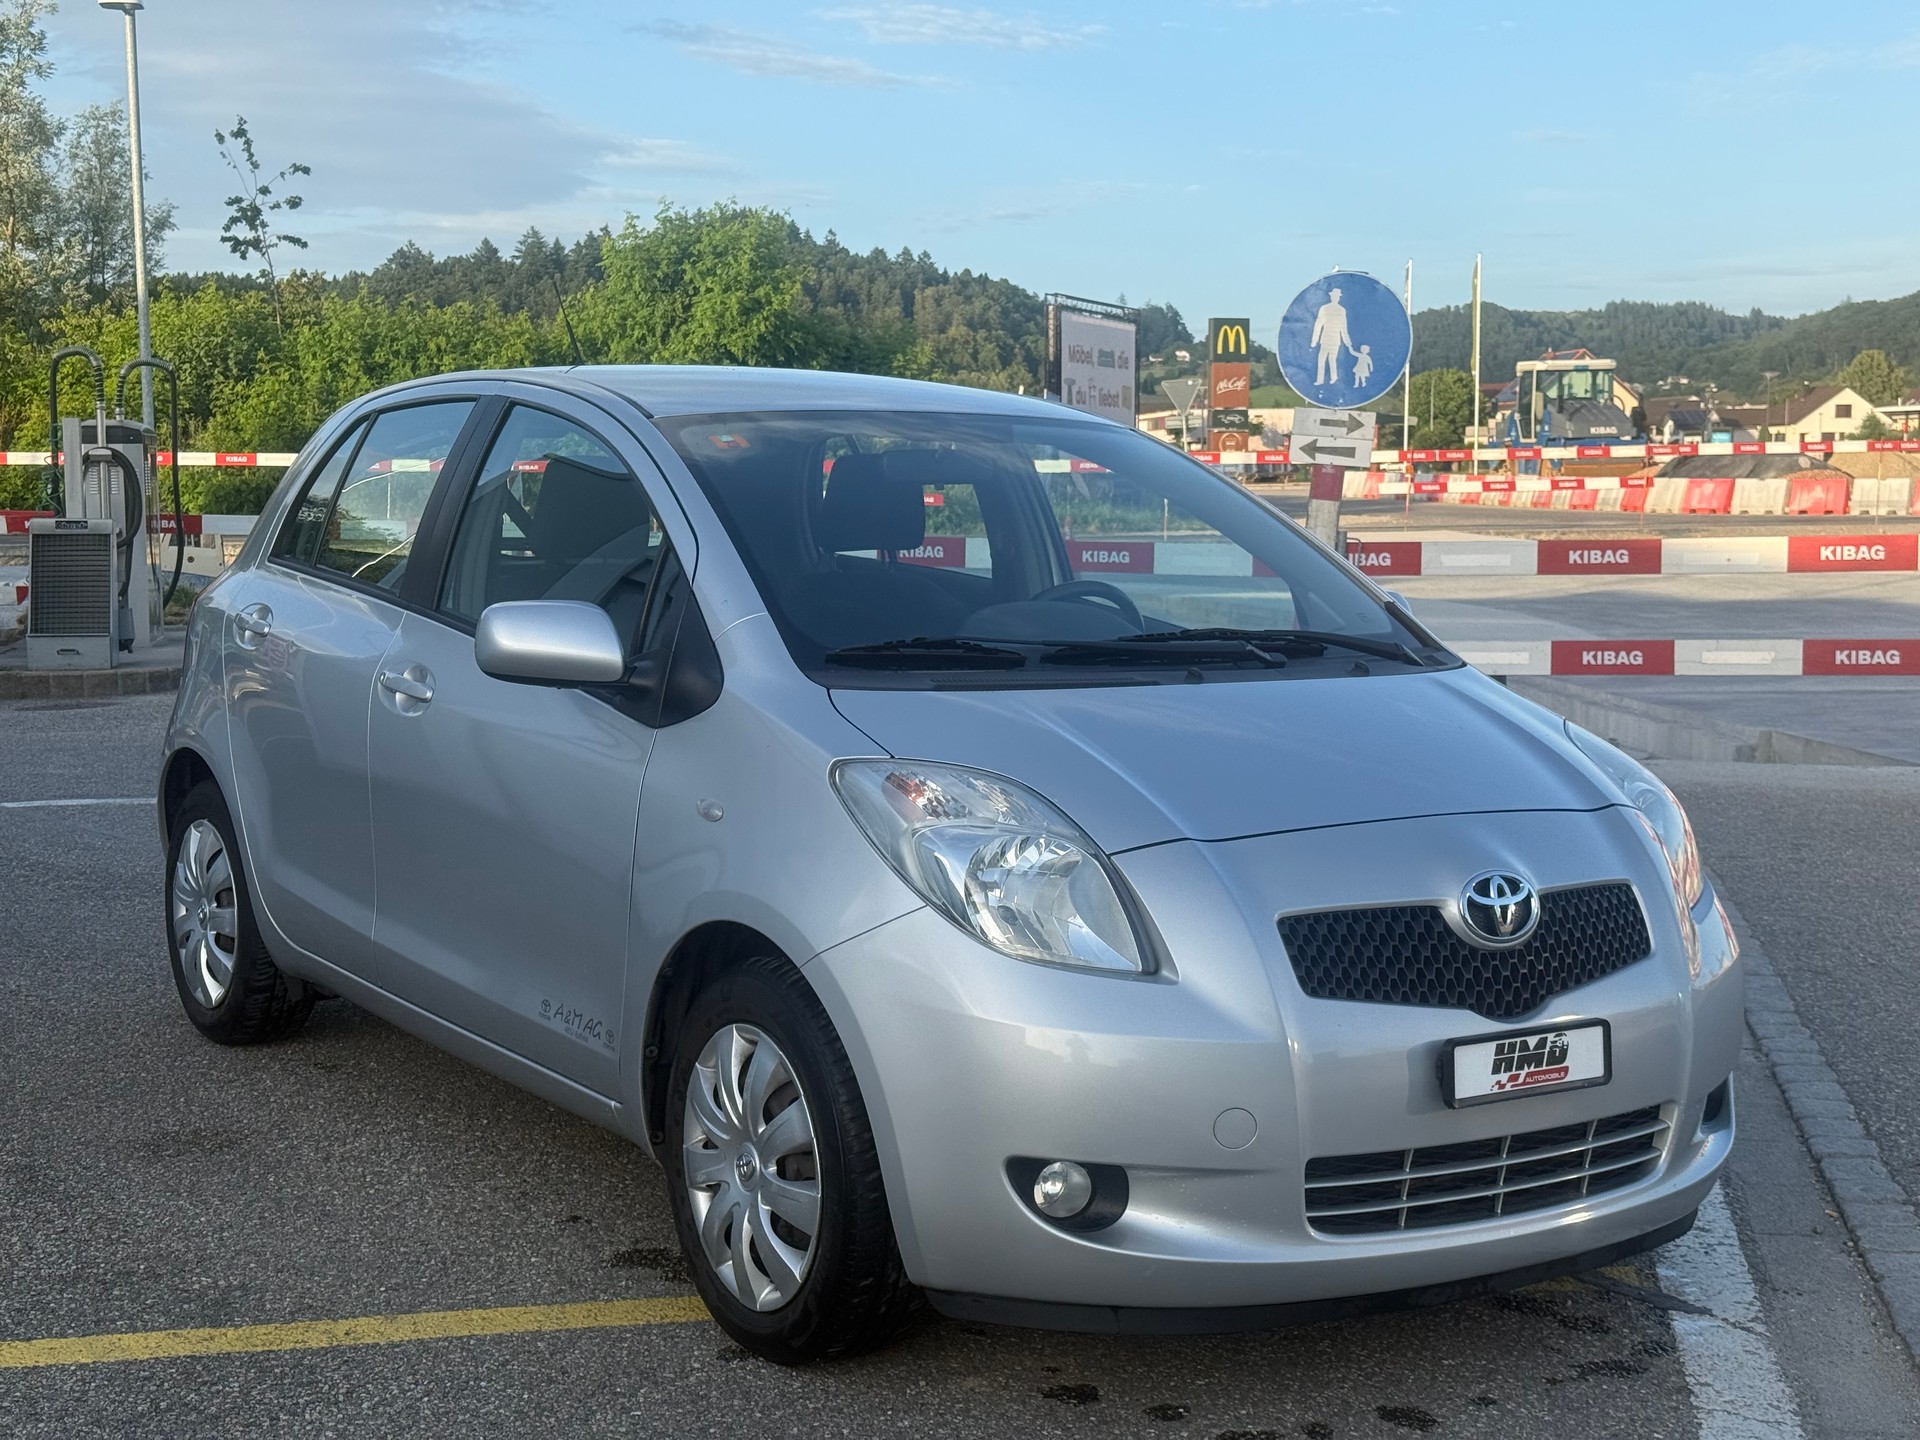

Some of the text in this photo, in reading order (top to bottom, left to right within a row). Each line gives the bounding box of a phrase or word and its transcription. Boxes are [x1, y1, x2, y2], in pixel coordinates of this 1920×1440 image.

[1590, 426, 1618, 434] KIBAG
[1082, 550, 1130, 564] KIBAG
[1348, 552, 1392, 567] IBAG
[1568, 549, 1630, 565] KIBAG
[1820, 544, 1886, 561] KIBAG
[1582, 650, 1643, 665] KIBAG
[1835, 649, 1901, 665] KIBAG
[583, 1018, 603, 1040] AG
[1525, 1071, 1565, 1083] AUTOMOBILE
